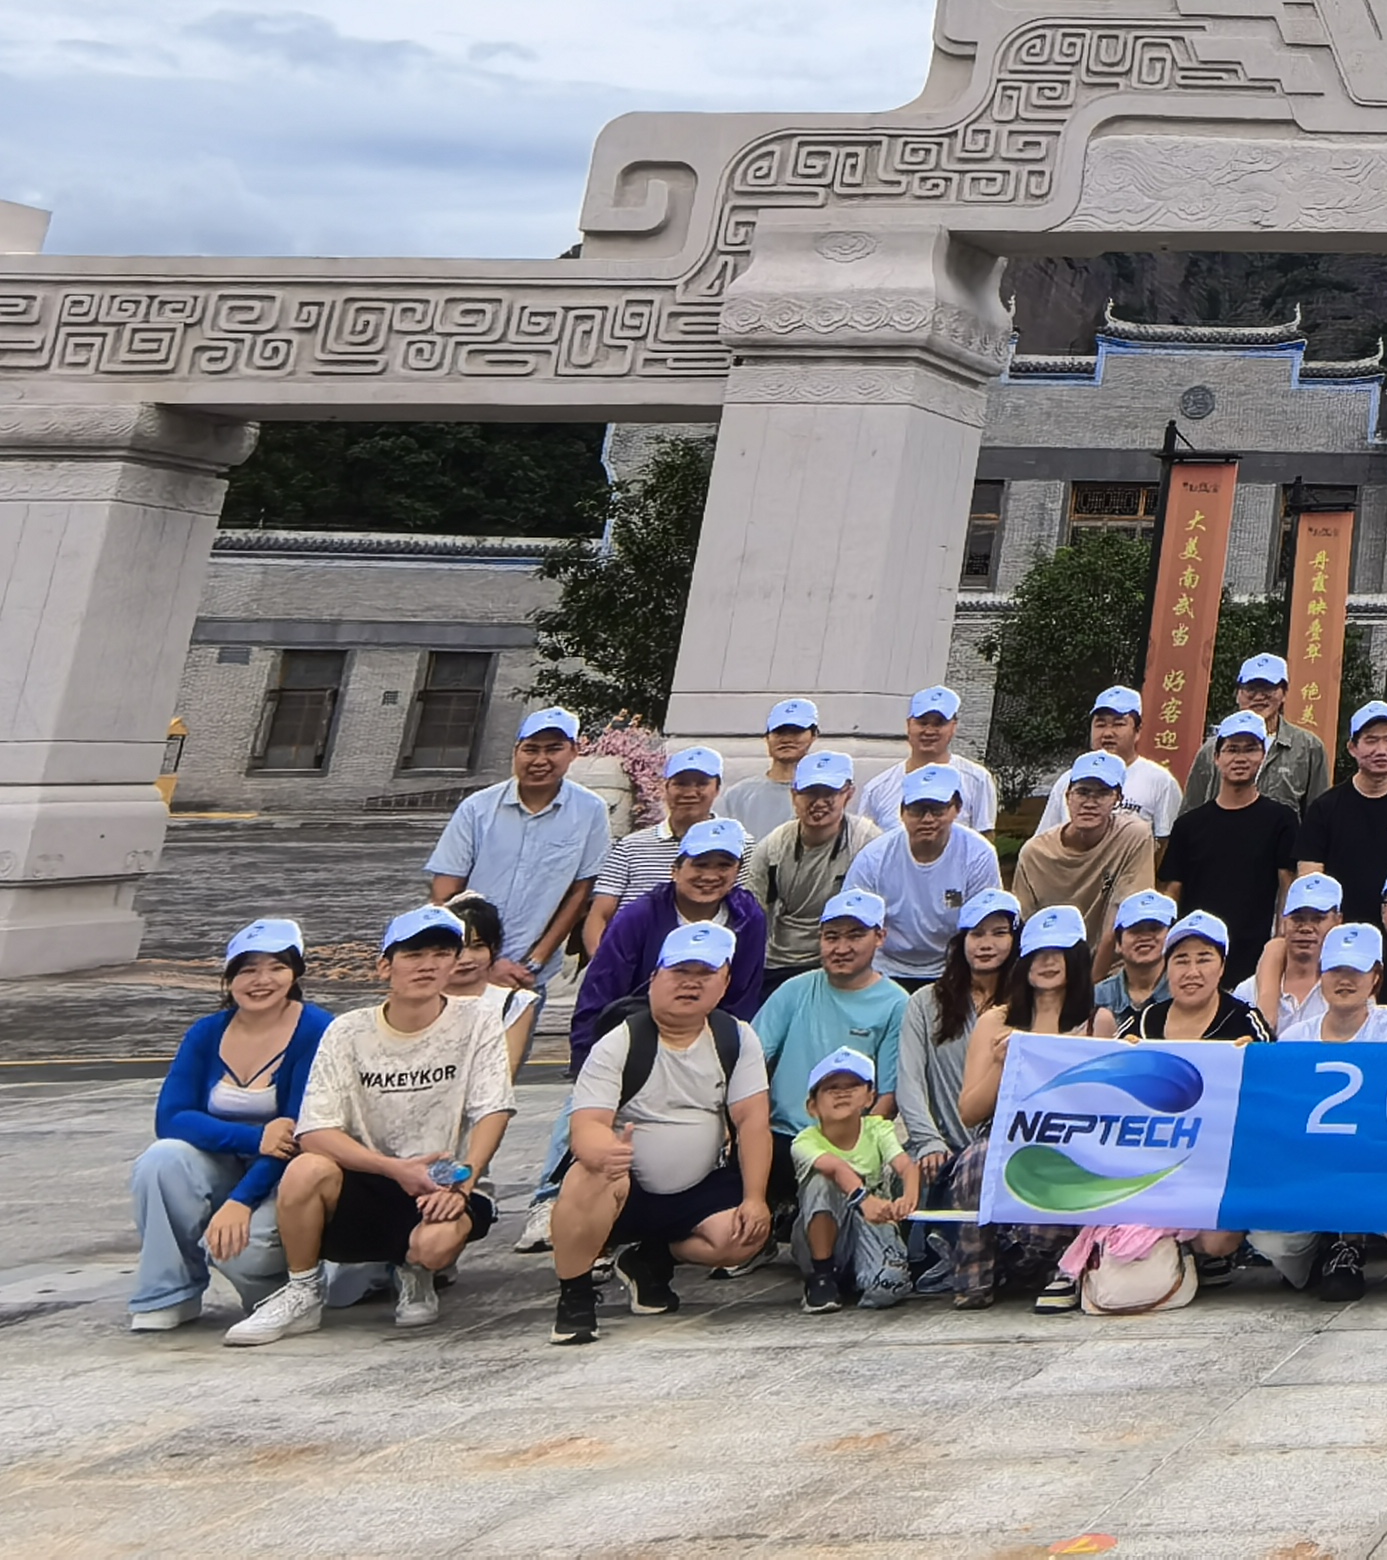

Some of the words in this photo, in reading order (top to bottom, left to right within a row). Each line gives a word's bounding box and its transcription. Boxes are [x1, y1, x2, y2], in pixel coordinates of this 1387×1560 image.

[1153, 668, 1187, 769] 好客迎
[359, 1064, 458, 1089] WAKEYKOR
[1007, 1110, 1203, 1150] NEPTECH
